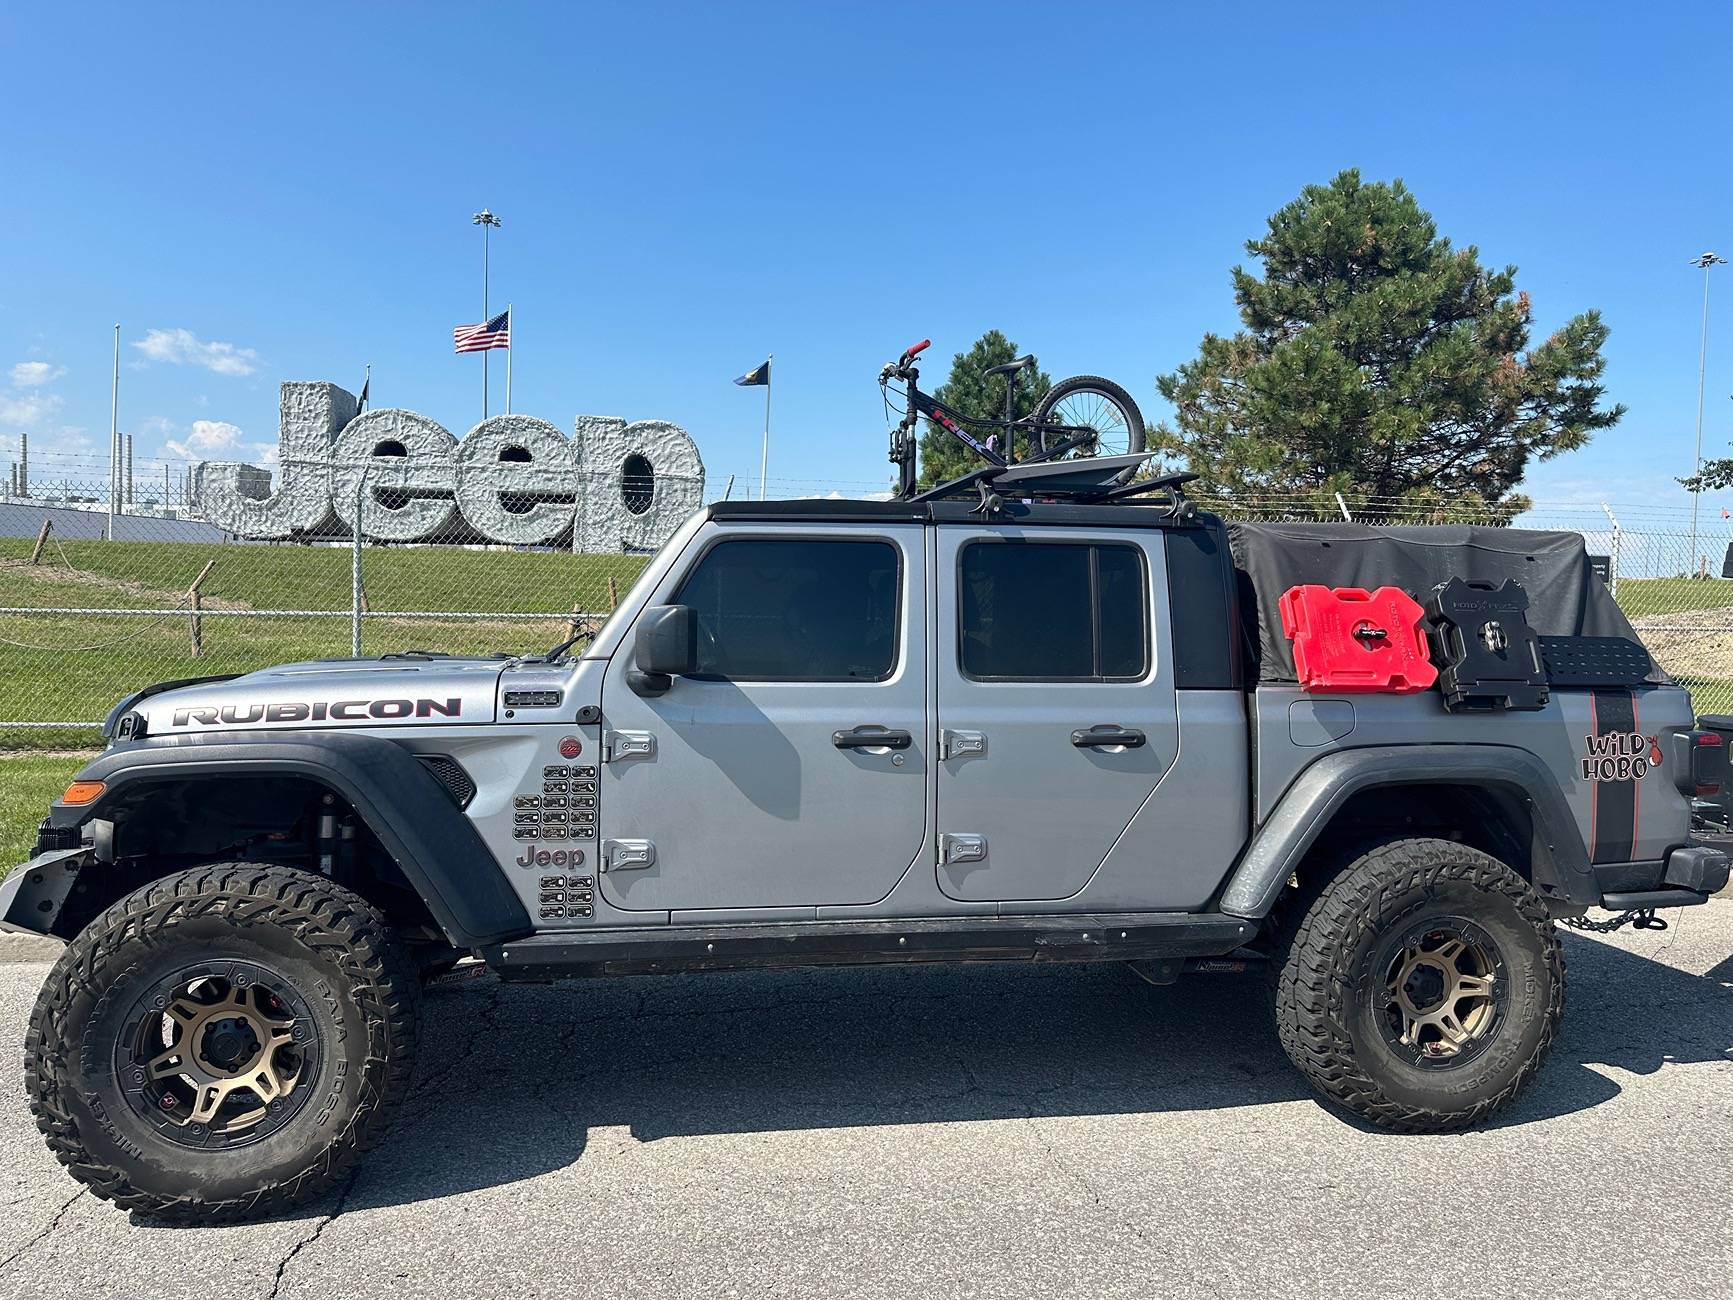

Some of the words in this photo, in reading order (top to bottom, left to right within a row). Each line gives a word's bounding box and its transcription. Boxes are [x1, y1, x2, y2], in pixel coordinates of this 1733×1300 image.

[931, 409, 987, 453] TREK
[194, 379, 705, 554] Jeep
[172, 697, 463, 727] RUBICON
[1581, 756, 1649, 781] HOBO
[516, 844, 585, 870] Jeep
[313, 979, 348, 1044] BAJA
[1520, 962, 1537, 1025] MICKEY
[313, 1058, 349, 1127] BOSS
